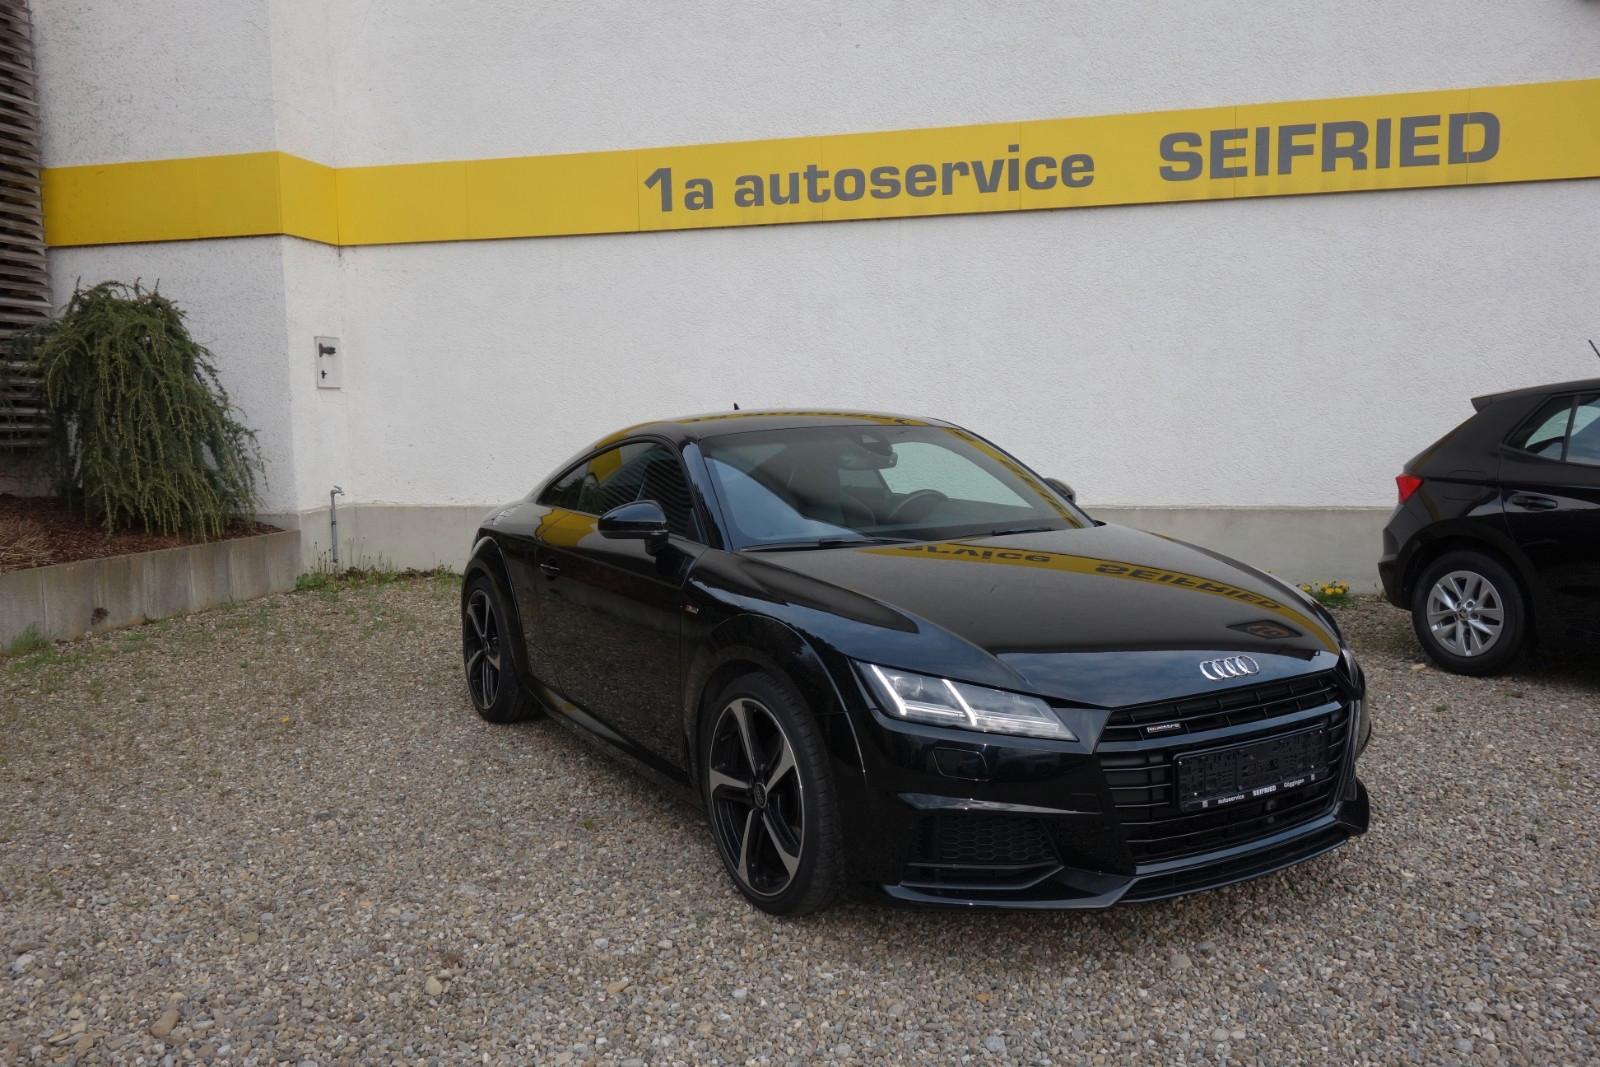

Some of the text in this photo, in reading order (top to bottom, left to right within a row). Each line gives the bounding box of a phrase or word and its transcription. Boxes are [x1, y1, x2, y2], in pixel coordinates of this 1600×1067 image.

[645, 111, 1501, 212] 1a autoservice SEIFRIED
